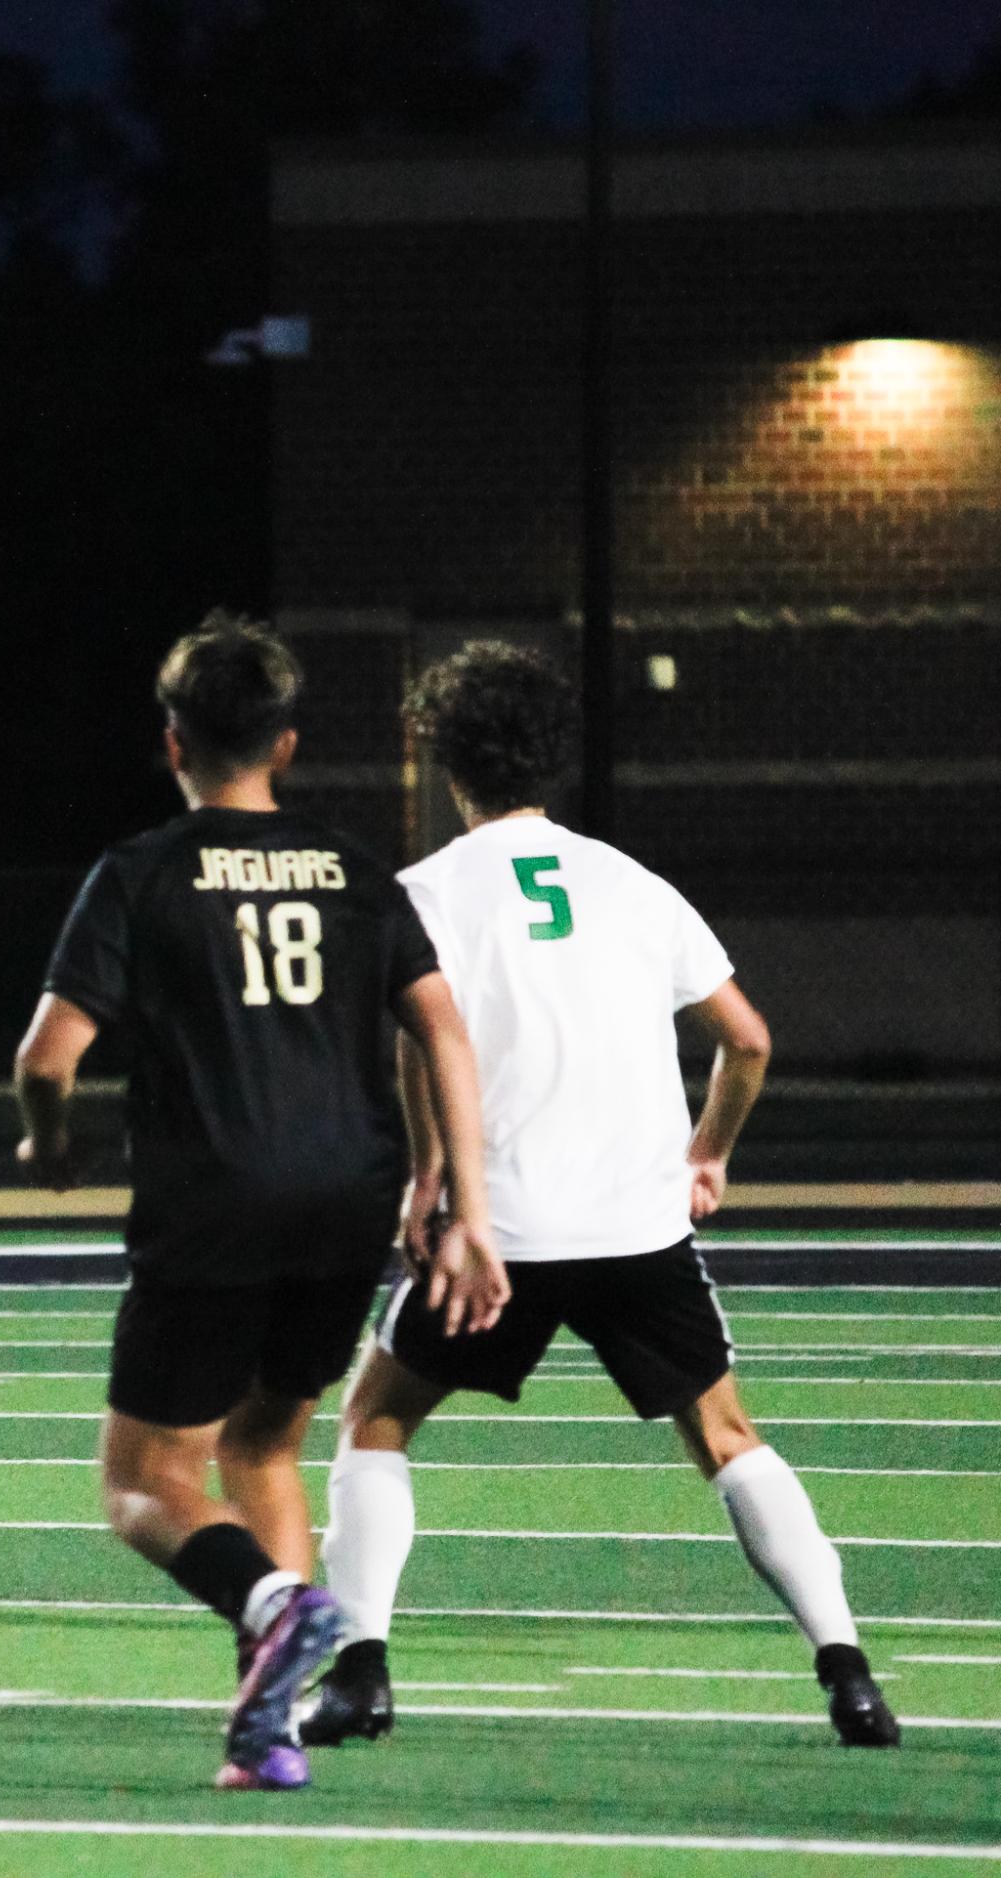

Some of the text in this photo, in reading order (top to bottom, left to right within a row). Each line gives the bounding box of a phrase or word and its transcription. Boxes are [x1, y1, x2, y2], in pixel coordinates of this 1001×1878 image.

[193, 848, 346, 891] JAGUARS
[511, 855, 574, 940] 5
[235, 902, 323, 1005] 18
